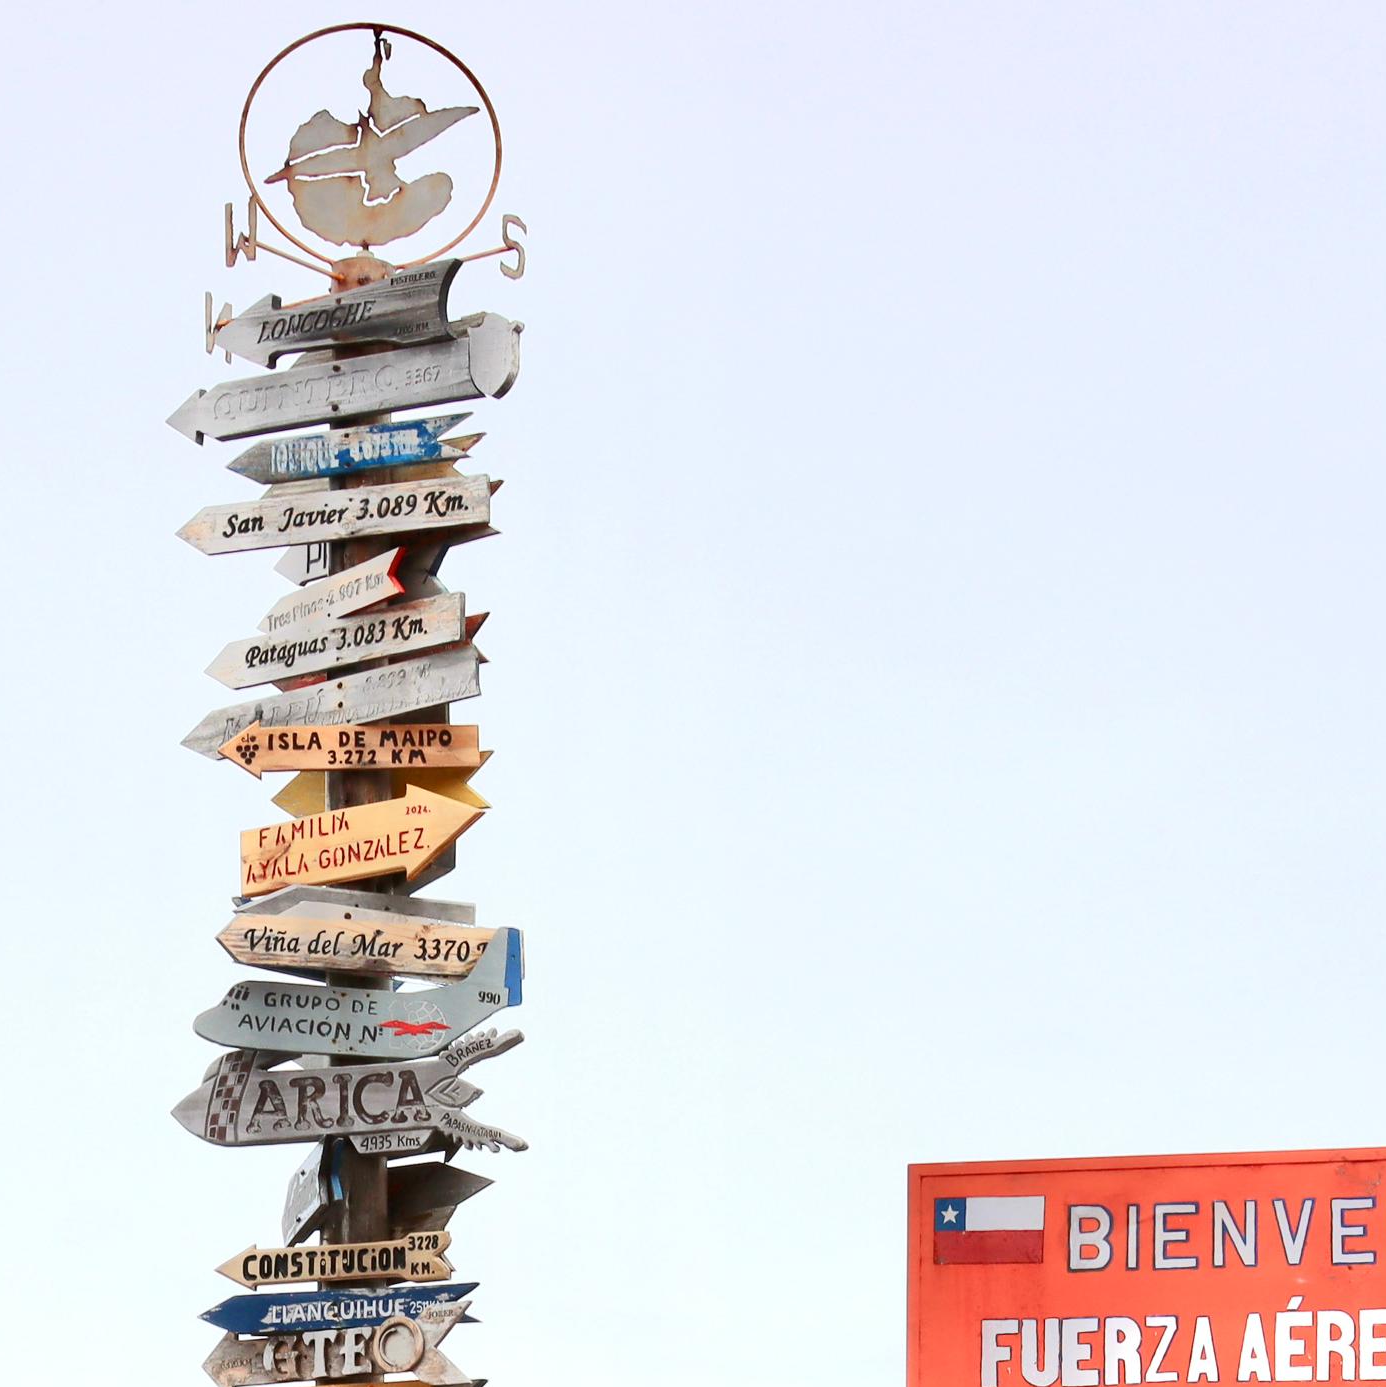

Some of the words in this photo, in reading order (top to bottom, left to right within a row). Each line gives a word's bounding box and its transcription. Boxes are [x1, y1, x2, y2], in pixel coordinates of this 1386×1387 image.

[223, 515, 264, 538] San
[279, 504, 349, 532] Javier
[356, 494, 418, 521] 3.089
[424, 491, 469, 516] Km.
[245, 636, 328, 669] Pataguas
[336, 621, 386, 651] 3.083
[392, 616, 428, 641] Km.
[267, 731, 322, 750] ISLA
[339, 731, 365, 748] DE
[380, 729, 452, 748] MAIPO
[328, 750, 377, 764] 3.272
[392, 749, 426, 764] KM
[259, 812, 349, 848] FAMILIA
[246, 853, 310, 884] AYALA
[244, 926, 300, 955] Viña
[308, 929, 341, 956] del
[351, 933, 404, 959] Mar
[414, 937, 471, 962] 3370
[264, 992, 340, 1011] GRUPO
[352, 999, 378, 1015] DE
[238, 1013, 351, 1041] AVIACIÓN
[246, 1070, 433, 1134] ARICA
[397, 1134, 421, 1148] Kms
[408, 1235, 439, 1250] 3228
[271, 1298, 405, 1325] LLANQUIHUE
